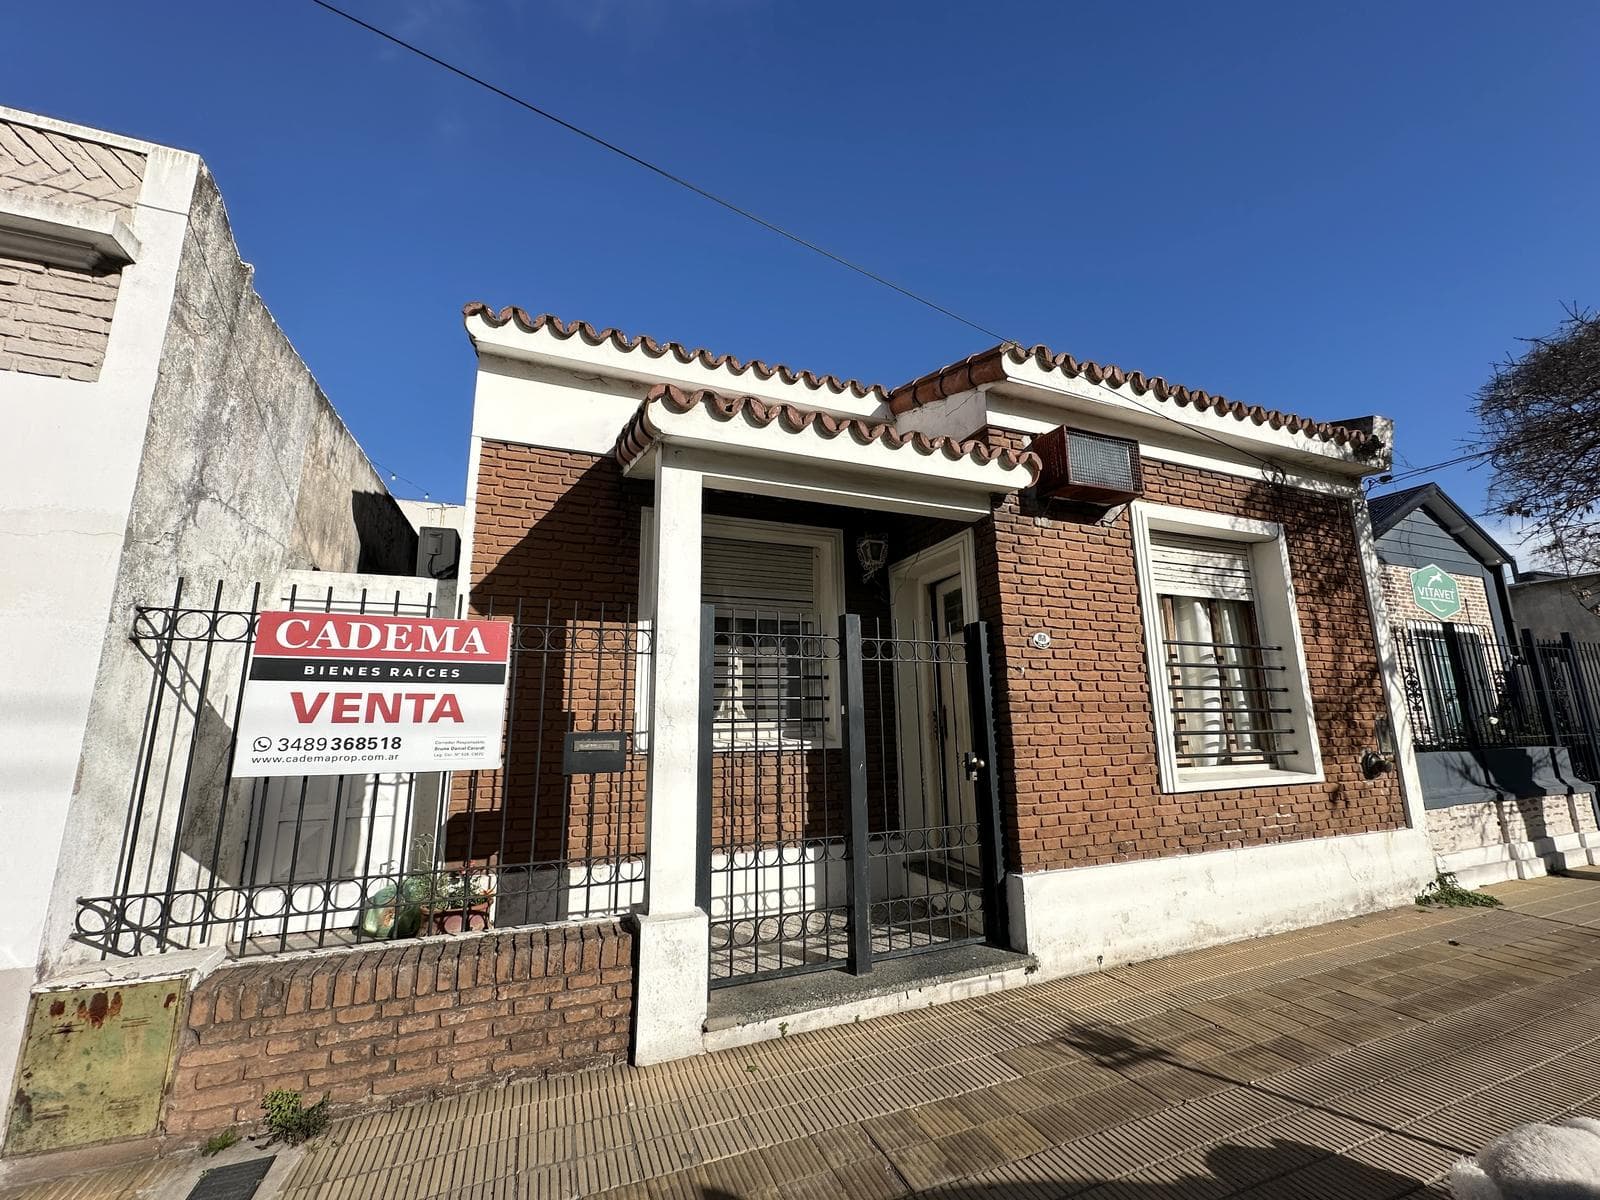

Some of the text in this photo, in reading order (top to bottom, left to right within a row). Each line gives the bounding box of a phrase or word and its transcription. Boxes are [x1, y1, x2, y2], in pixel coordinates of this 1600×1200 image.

[1417, 586, 1455, 600] VITAVET
[276, 618, 490, 655] CADEMA
[303, 665, 461, 678] BIENES RAÍCES
[290, 692, 464, 723] VENTA
[251, 754, 399, 763] www.cademaprop.com.ar
